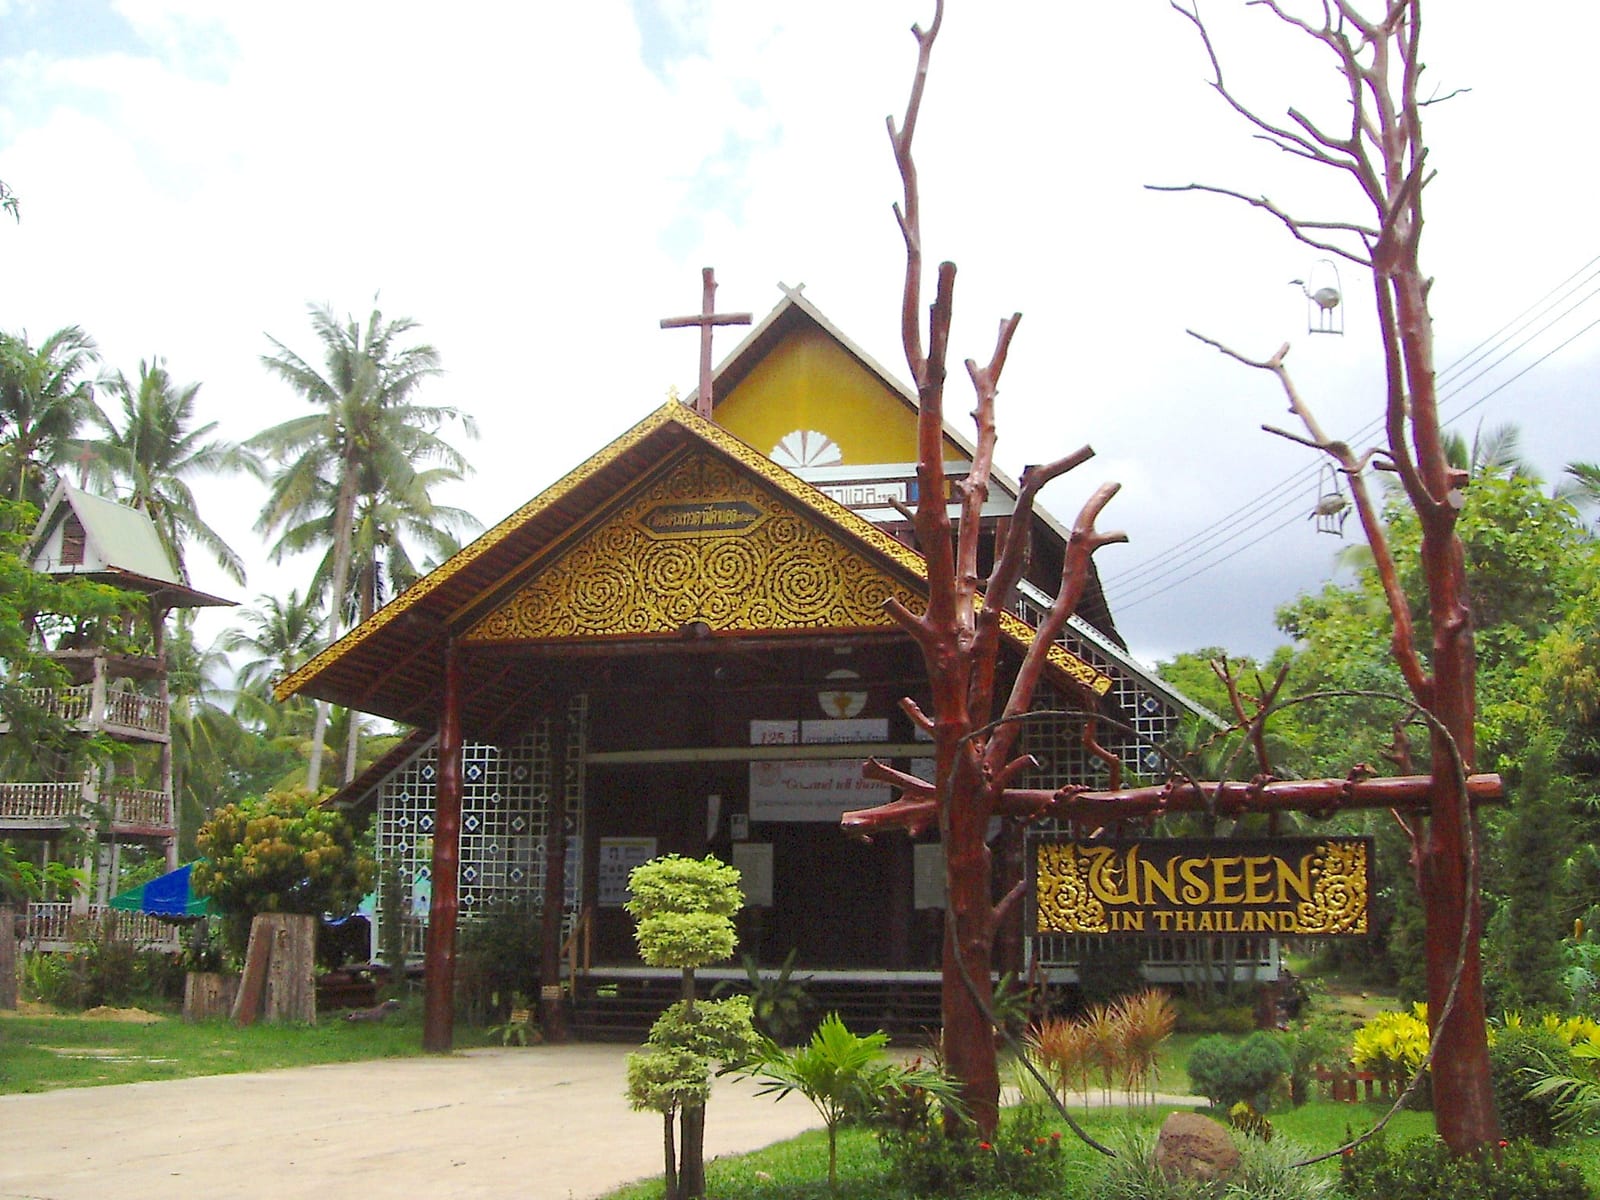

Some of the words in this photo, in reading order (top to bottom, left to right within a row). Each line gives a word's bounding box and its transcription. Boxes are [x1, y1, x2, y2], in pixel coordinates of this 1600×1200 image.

[1078, 843, 1315, 906] UNSEEN
[1110, 911, 1146, 932] IN
[1152, 910, 1300, 932] THAILAND
